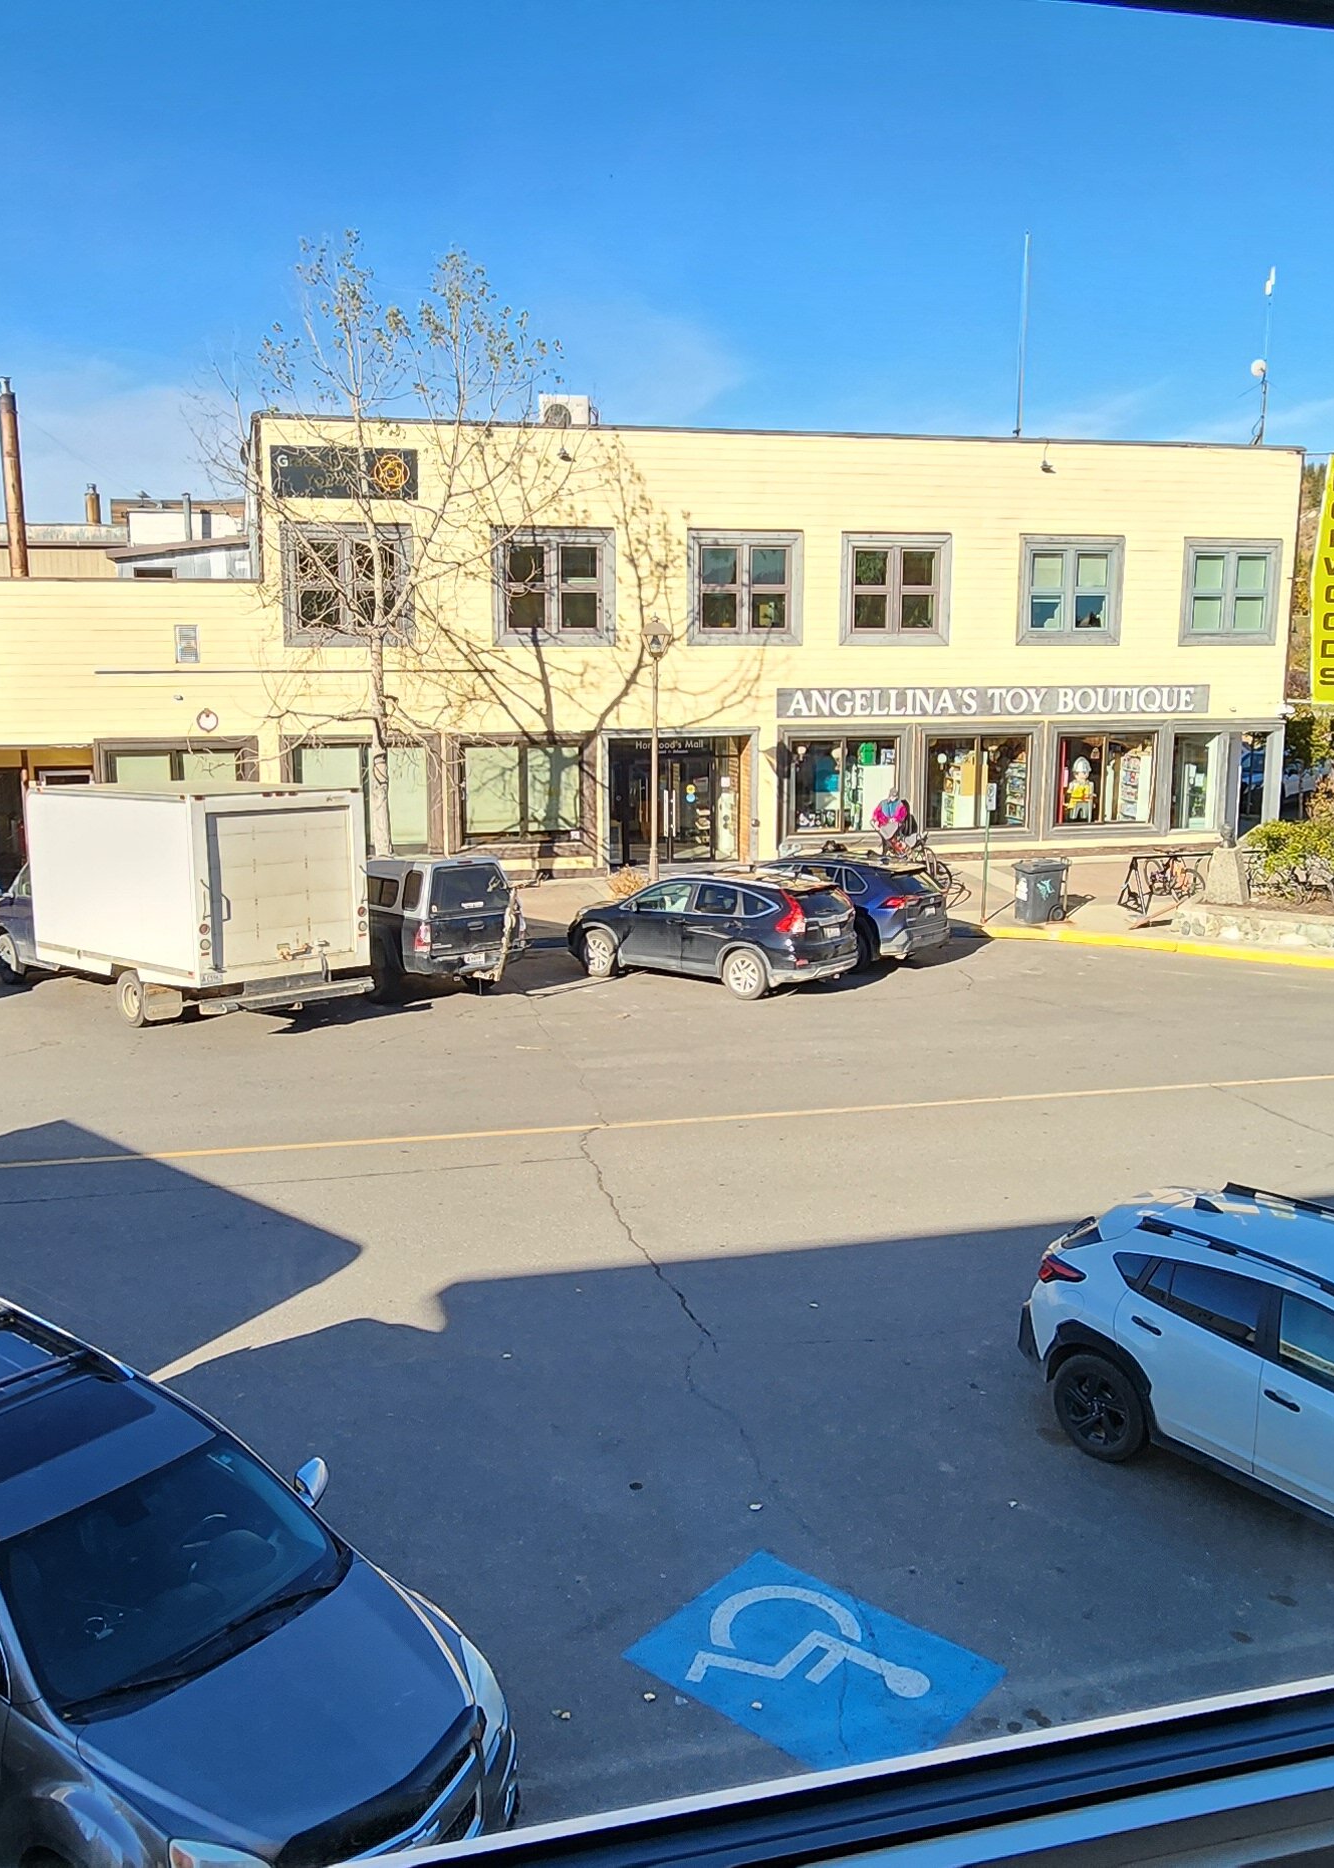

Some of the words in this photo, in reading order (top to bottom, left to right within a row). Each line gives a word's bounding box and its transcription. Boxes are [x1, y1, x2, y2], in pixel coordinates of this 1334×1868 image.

[786, 689, 978, 717] ANGELLINA'S
[988, 688, 1047, 714] TOY
[1056, 687, 1196, 712] BOUTIQUE
[635, 740, 682, 750] Horood's
[684, 739, 704, 748] Mall
